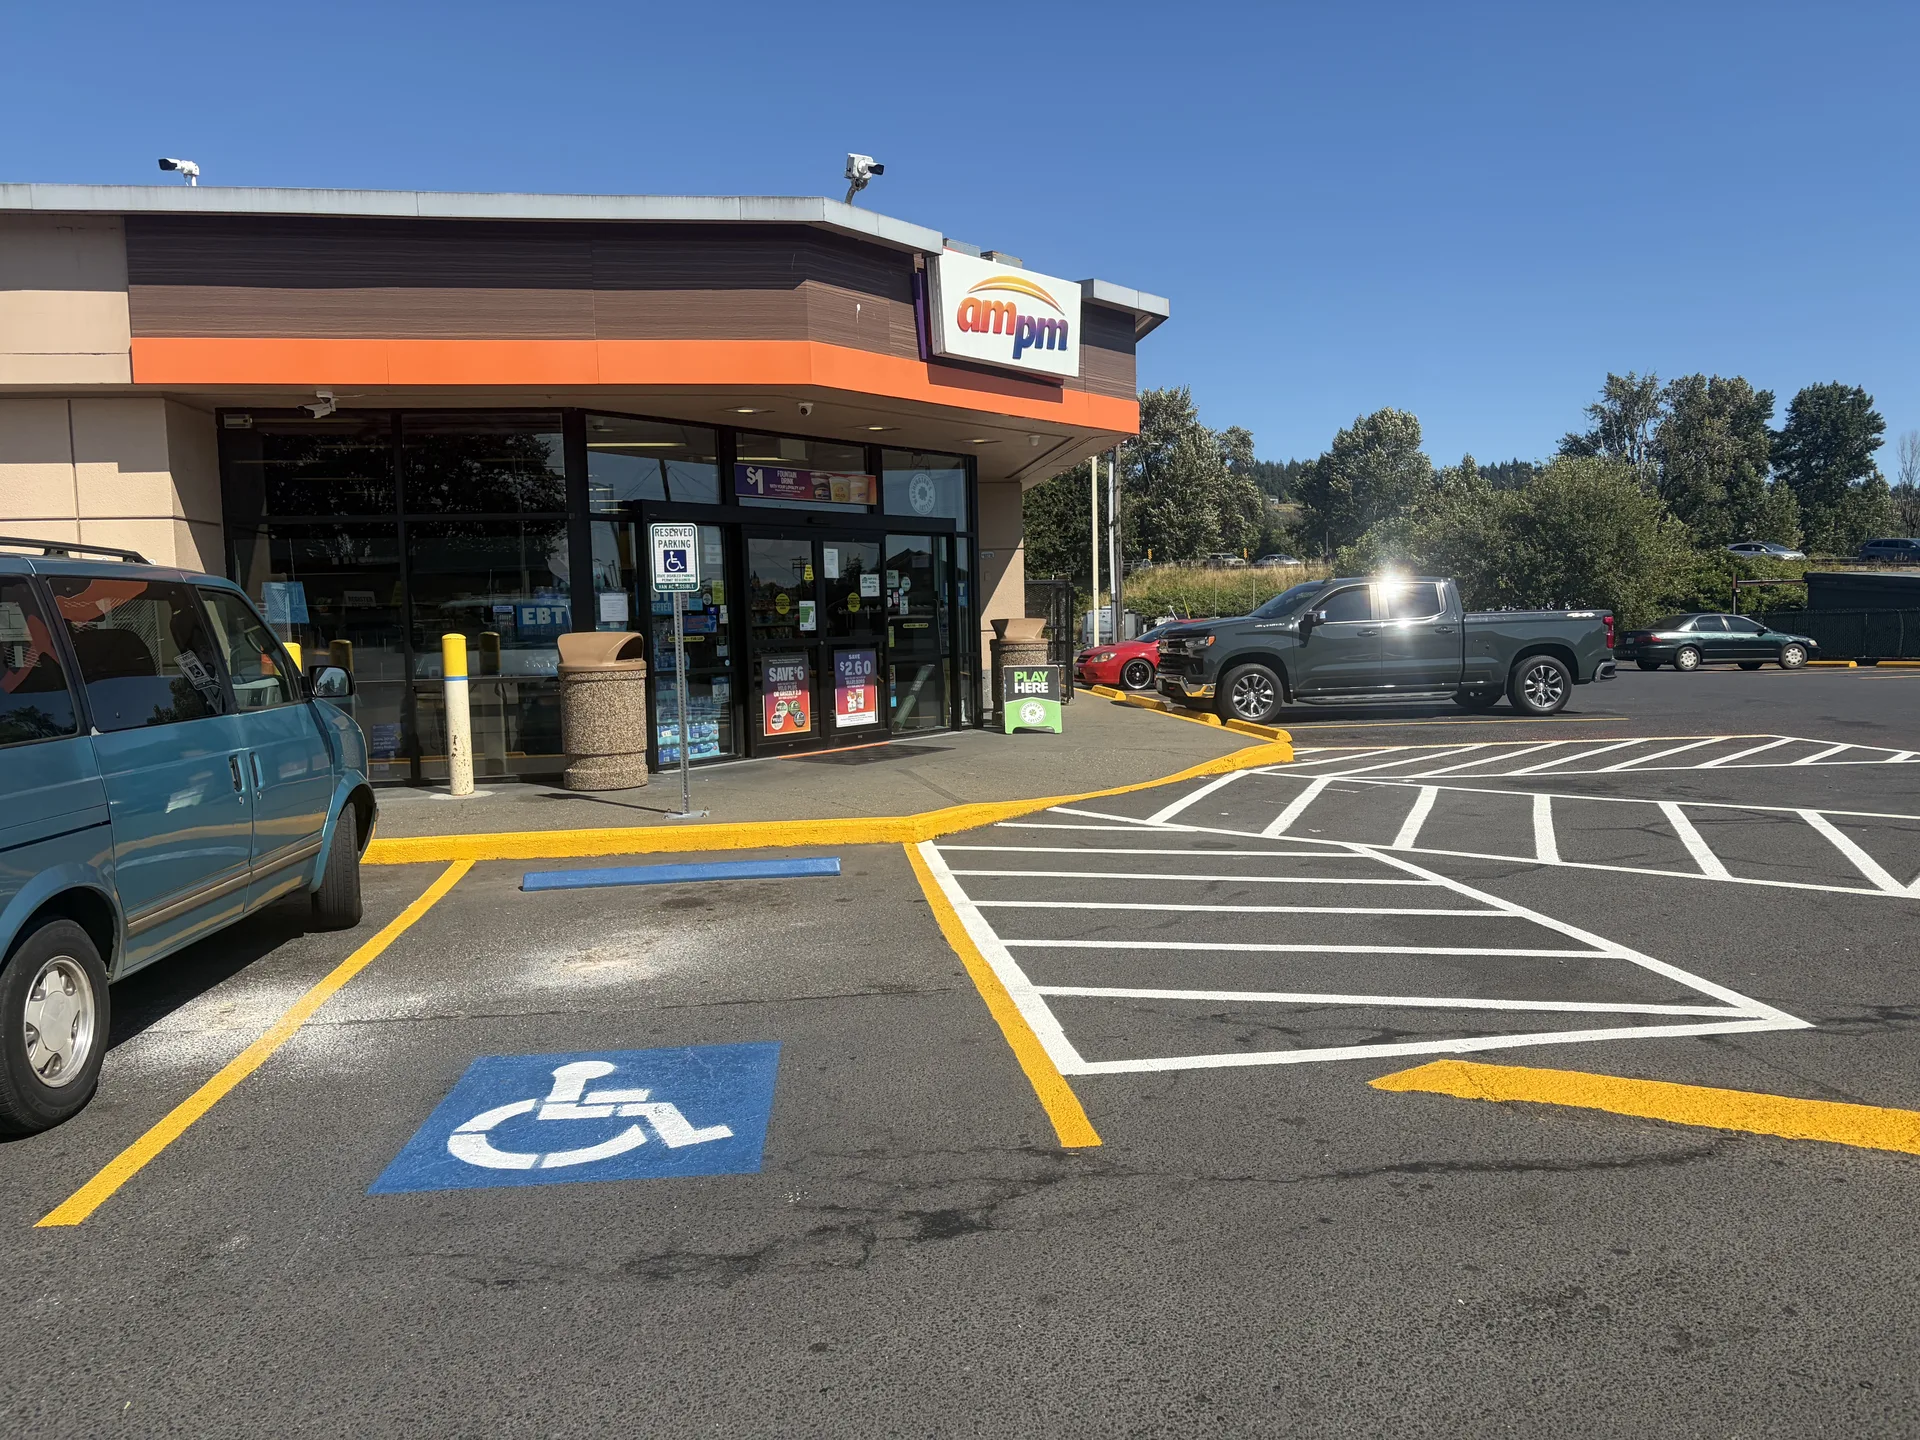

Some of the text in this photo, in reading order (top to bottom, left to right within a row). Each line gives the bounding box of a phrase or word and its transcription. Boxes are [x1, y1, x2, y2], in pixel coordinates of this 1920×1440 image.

[957, 297, 1069, 360] ampm
[746, 466, 765, 495] $1
[655, 528, 693, 537] RESERVED
[658, 540, 691, 548] PARKING
[522, 607, 566, 625] EBT
[769, 665, 804, 682] SAVE $6
[840, 660, 872, 676] $2.60
[1014, 671, 1049, 682] PLAY
[1014, 682, 1049, 694] HERE
